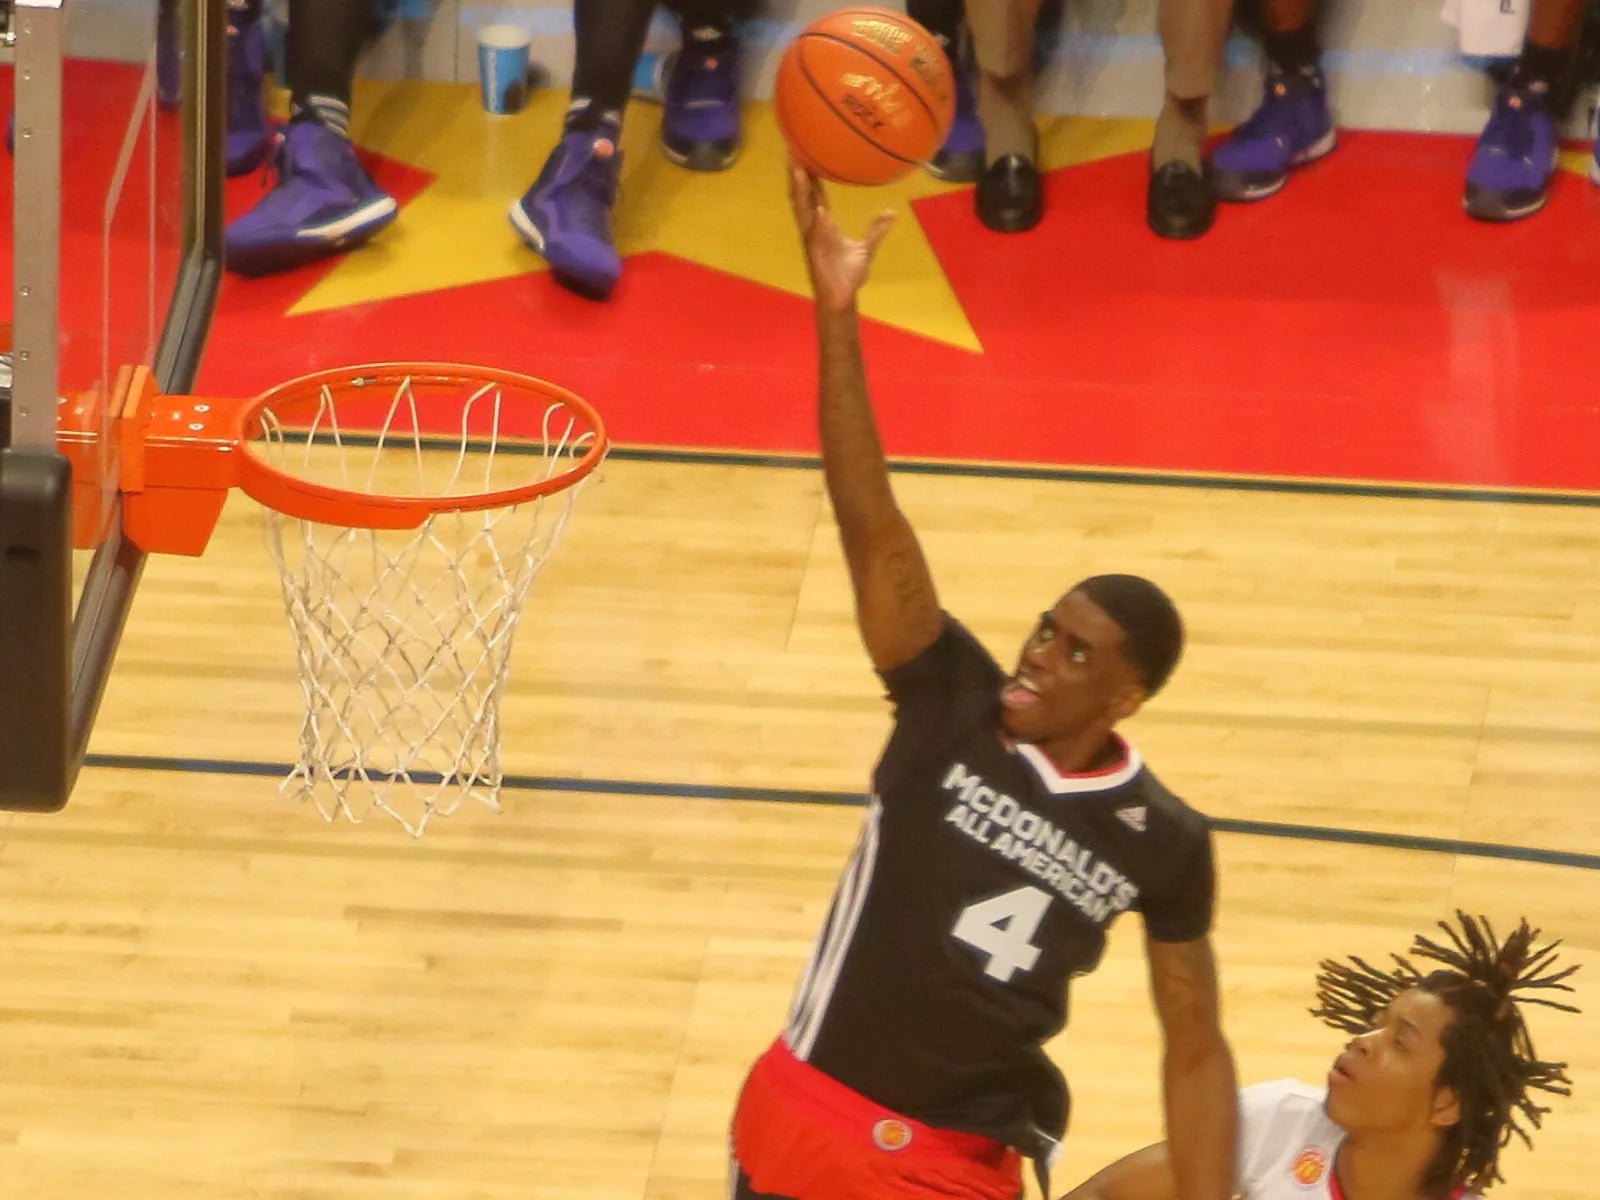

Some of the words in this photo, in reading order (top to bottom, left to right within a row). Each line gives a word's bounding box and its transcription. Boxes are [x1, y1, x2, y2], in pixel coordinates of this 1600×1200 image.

[942, 763, 1139, 911] MCDONALD'S
[945, 805, 991, 843] ALL
[990, 832, 1113, 922] AMERICAN
[952, 886, 1054, 982] 4
